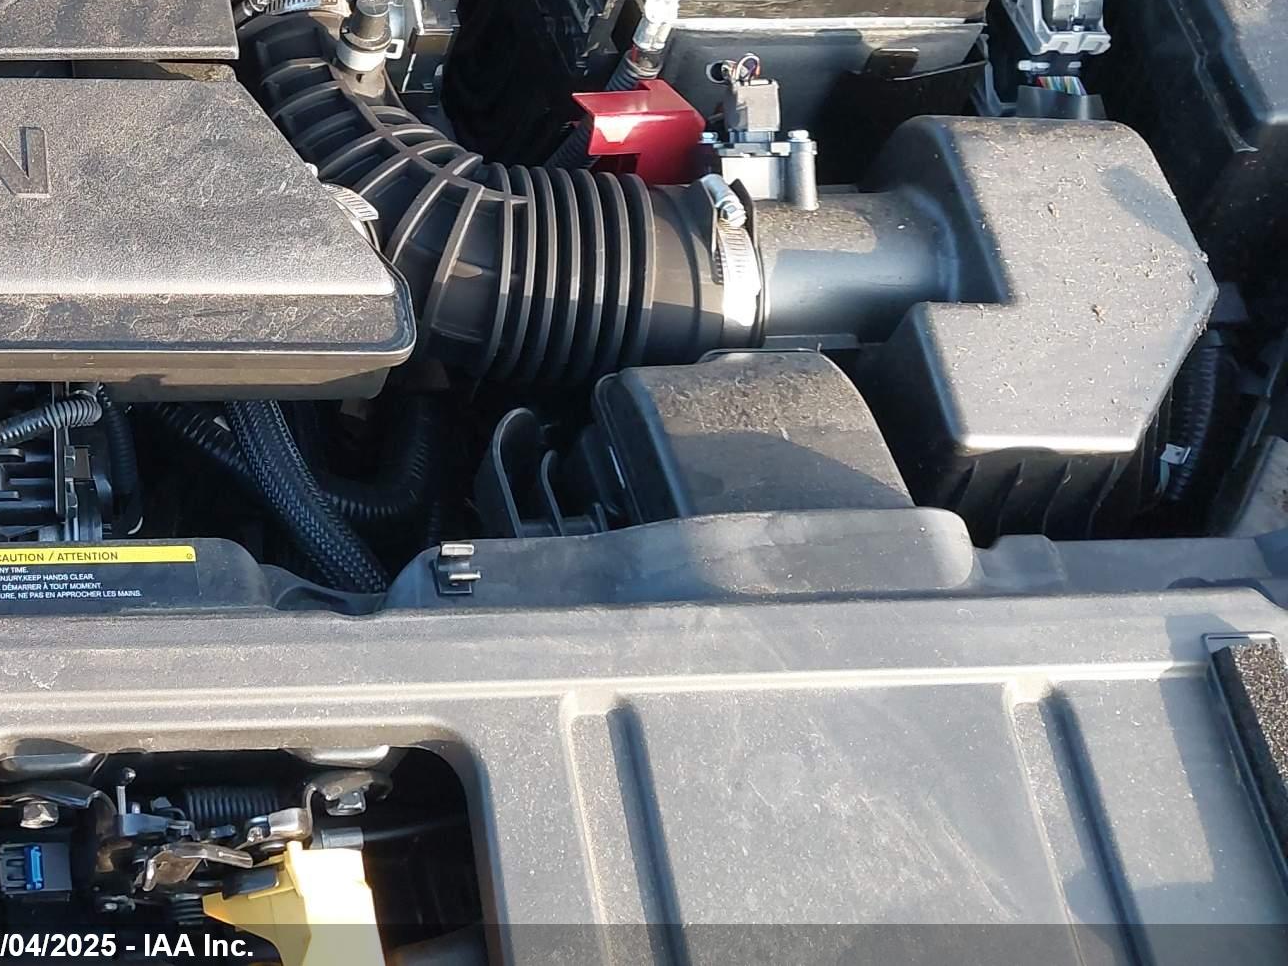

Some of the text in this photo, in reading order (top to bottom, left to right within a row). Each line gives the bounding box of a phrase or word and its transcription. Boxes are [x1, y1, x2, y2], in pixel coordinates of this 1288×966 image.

[48, 551, 54, 562] /
[57, 551, 119, 561] ATTENTION
[10, 566, 29, 574] TIME.
[42, 573, 69, 581] HANDS
[2, 582, 42, 591] DÉMARRER
[42, 581, 50, 590] À
[50, 582, 69, 590] TOUT
[29, 591, 44, 599] PAS
[56, 590, 103, 598] APPROCHER
[117, 589, 142, 597] MAINS.
